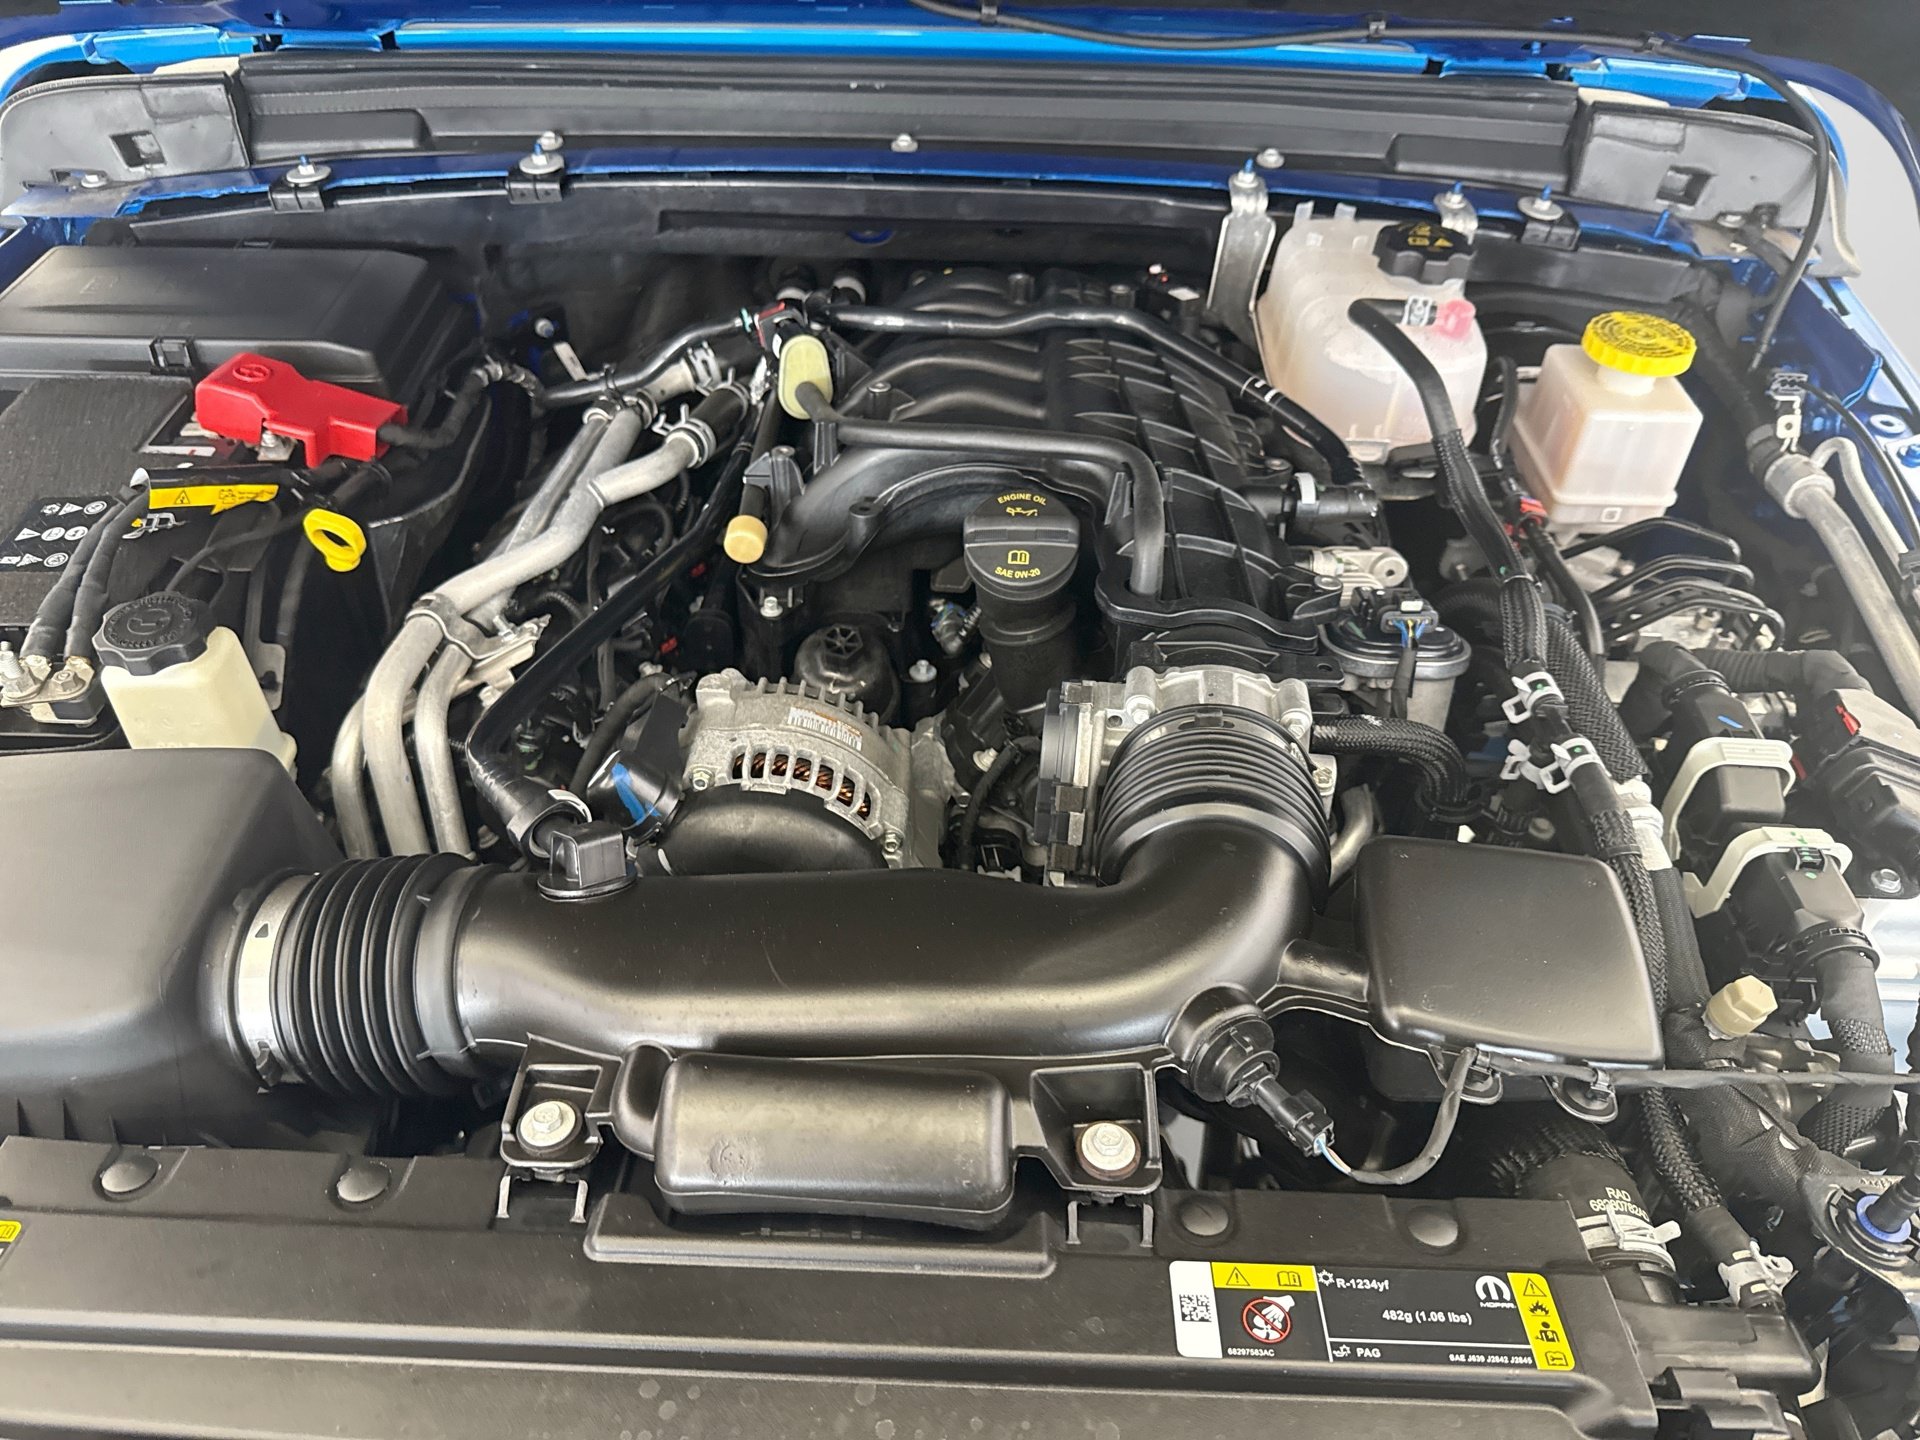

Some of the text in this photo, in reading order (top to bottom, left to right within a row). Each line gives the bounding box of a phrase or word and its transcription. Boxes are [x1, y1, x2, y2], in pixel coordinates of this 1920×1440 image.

[997, 493, 1047, 506] ENGINE OIL
[994, 566, 1041, 579] SAE 0W-20
[1605, 1186, 1632, 1202] RAD
[1335, 1277, 1390, 1292] R-1234yf
[1479, 1301, 1516, 1309] MOPAR
[1382, 1309, 1473, 1326] 482g (1.06 lbs)
[1356, 1347, 1382, 1358] PAG
[1448, 1353, 1467, 1362] SAE
